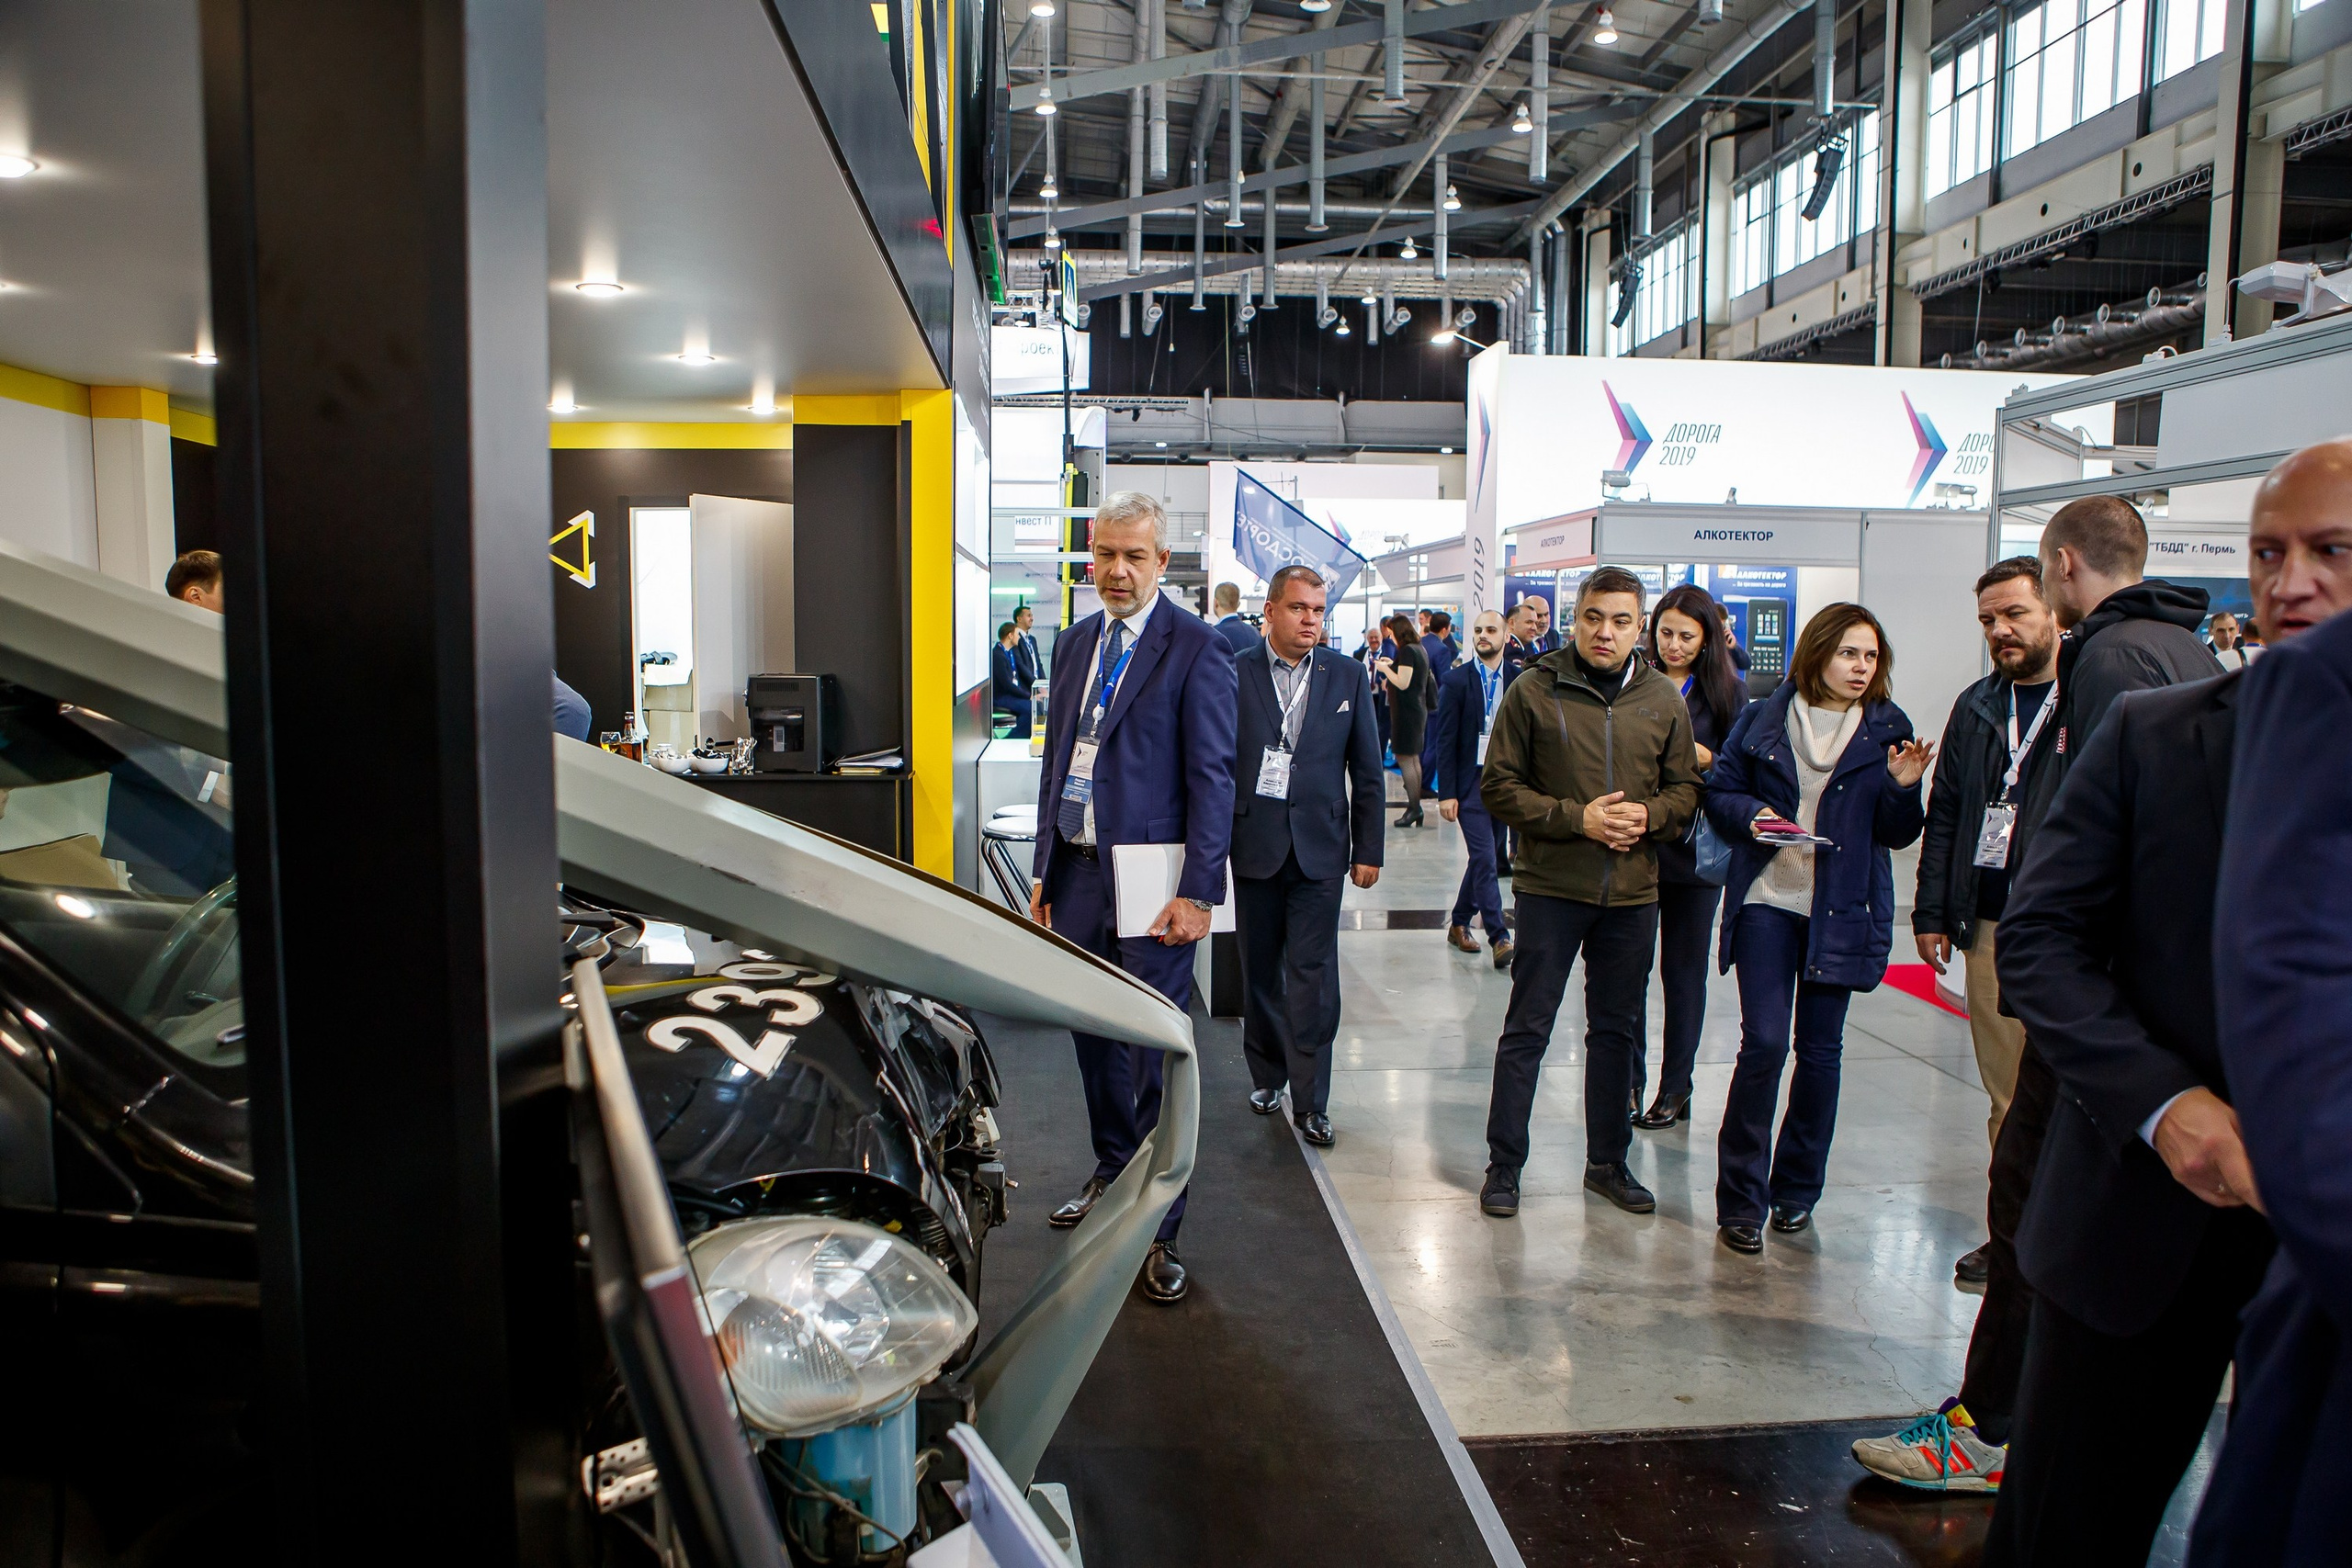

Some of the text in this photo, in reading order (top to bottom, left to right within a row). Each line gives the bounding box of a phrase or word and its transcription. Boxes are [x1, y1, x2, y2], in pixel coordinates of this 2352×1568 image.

[1662, 423, 1722, 445] ДОРОГА
[1659, 446, 1697, 466] 2019
[1953, 455, 1988, 475] 2019
[1015, 517, 1042, 525] нвест
[1540, 535, 1566, 548] АЛКОТЕКТОР
[1693, 529, 1774, 542] АЛКОТЕКТОР
[2150, 541, 2189, 554] "ТБДД"
[2200, 543, 2236, 556] Пермь
[1473, 536, 1485, 611] 2019
[1736, 570, 1787, 581] АЛКОТЕКТОР
[643, 948, 838, 1081] 239
